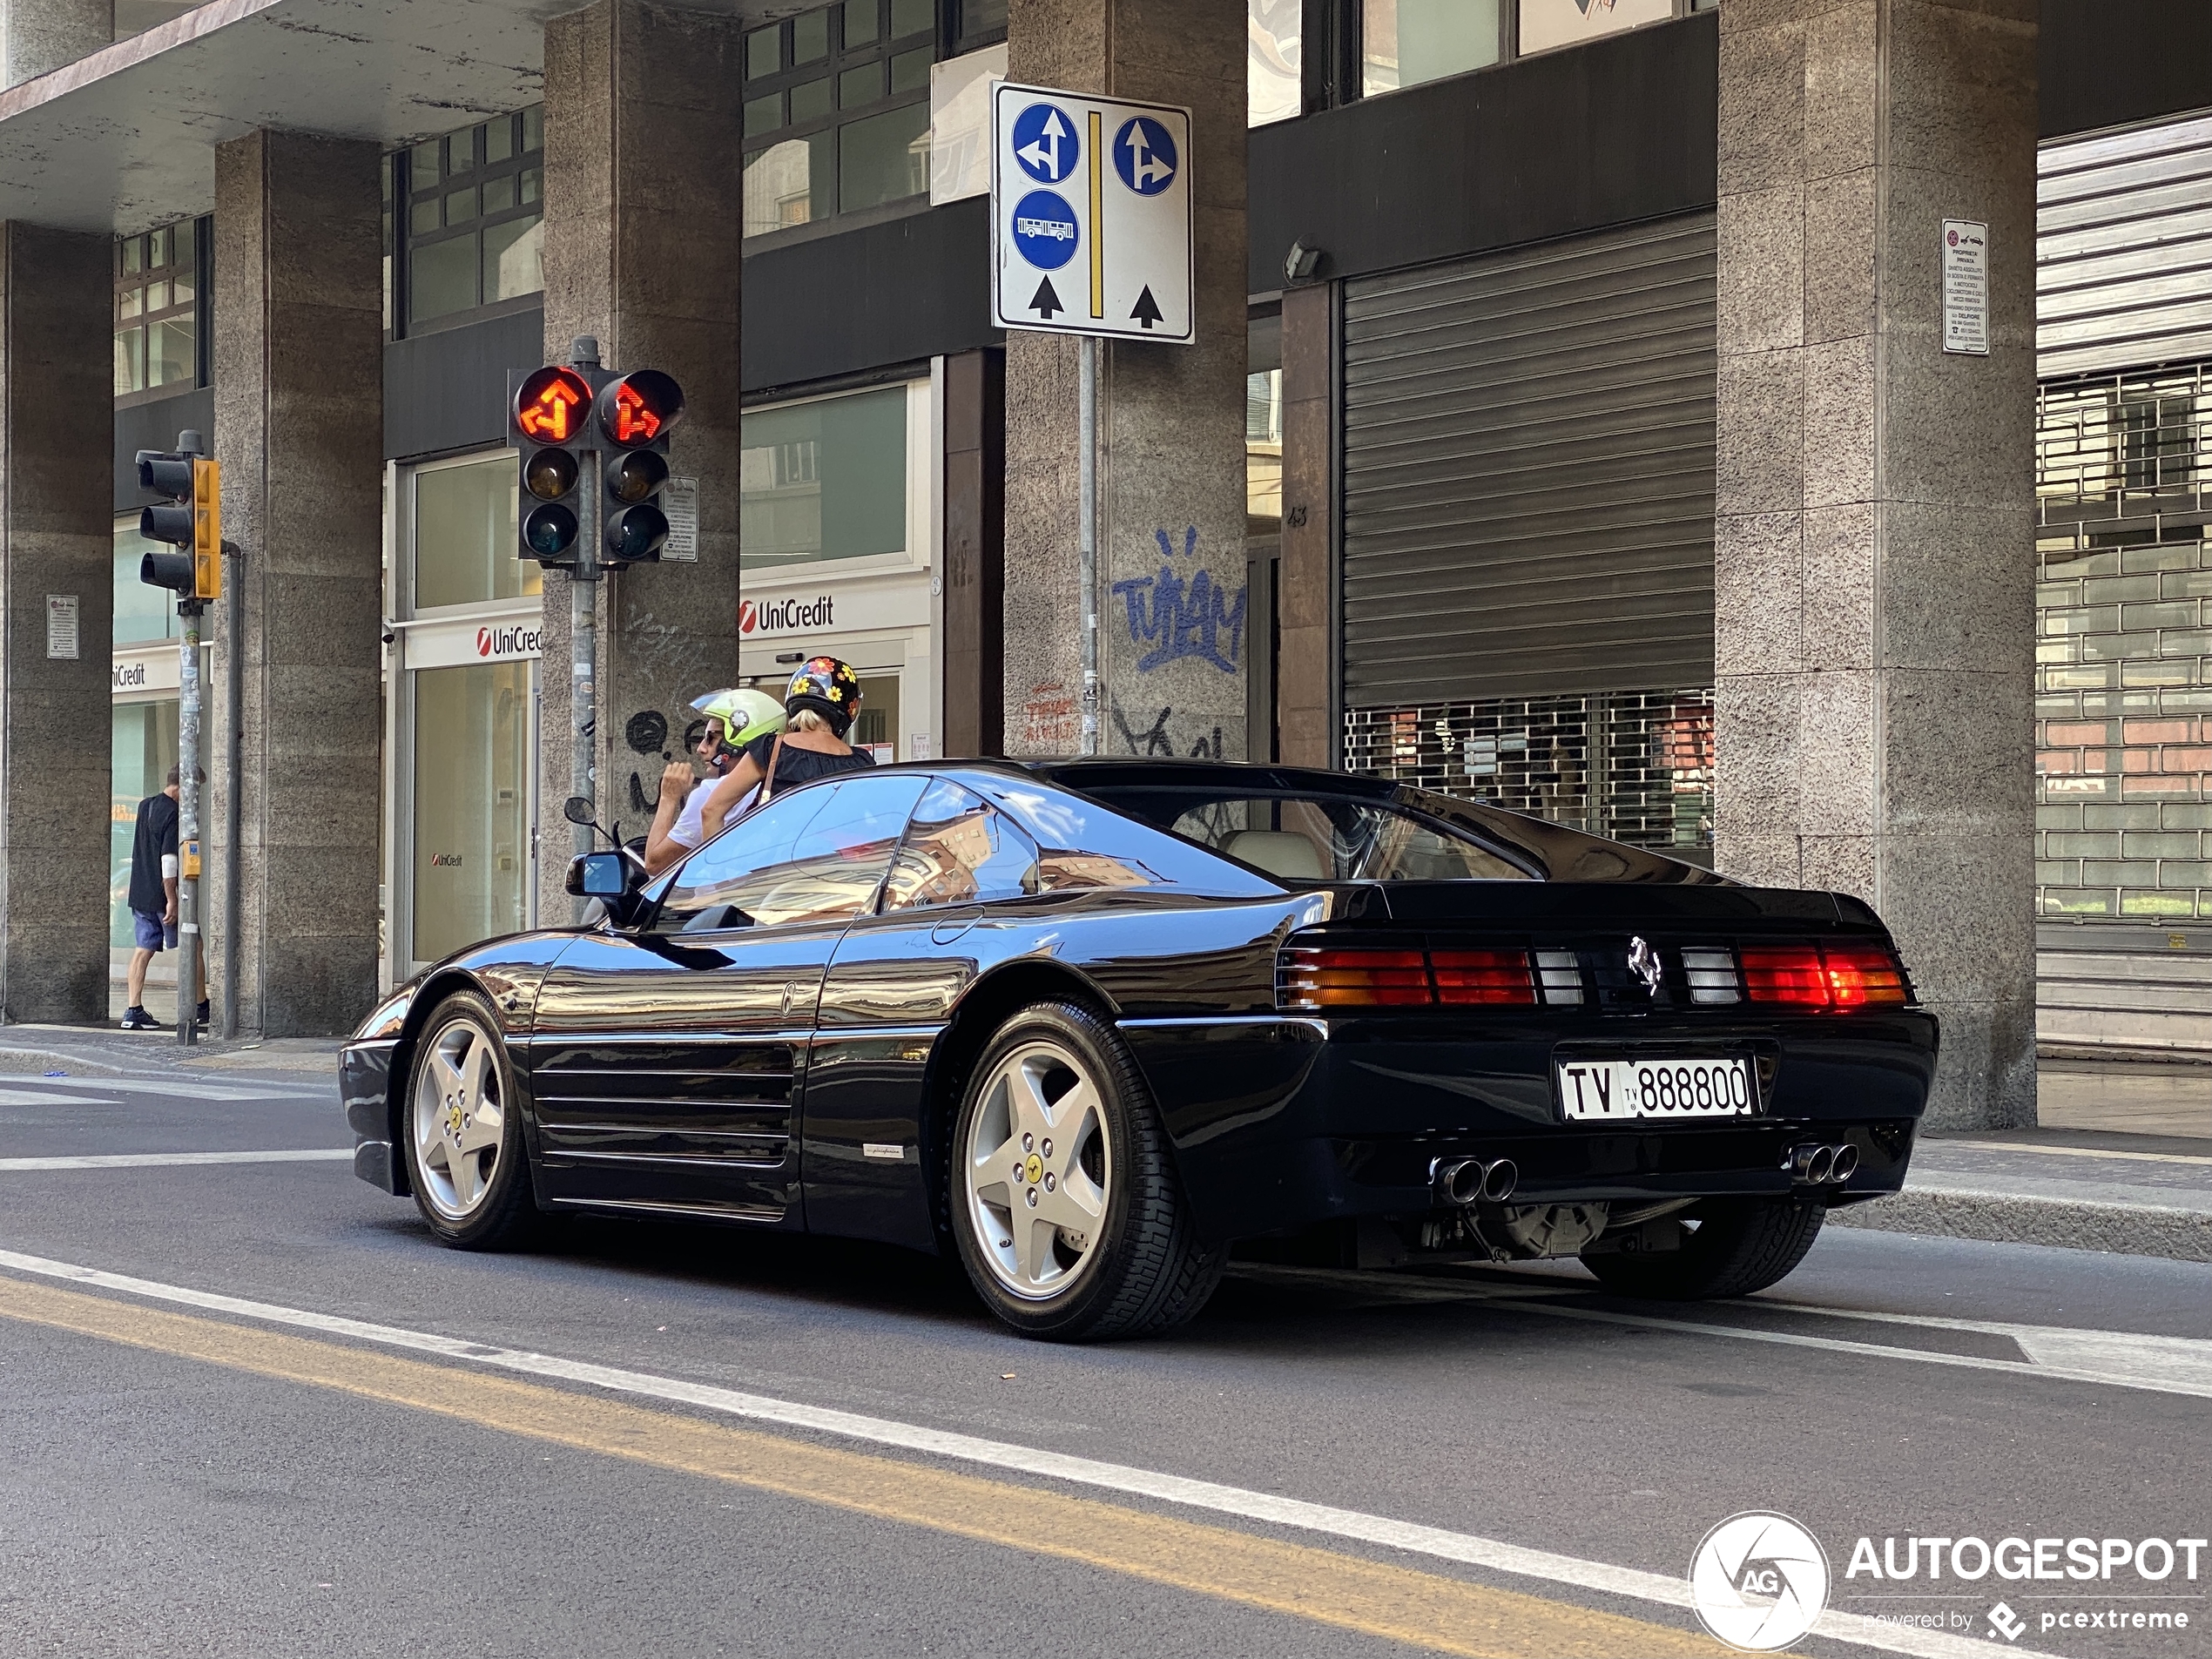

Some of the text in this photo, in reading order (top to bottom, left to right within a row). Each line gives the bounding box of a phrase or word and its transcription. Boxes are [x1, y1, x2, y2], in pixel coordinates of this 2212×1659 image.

[759, 595, 833, 631] UniCredit
[493, 625, 543, 655] UniCred
[438, 853, 462, 867] UniCredit
[1567, 1068, 1611, 1113] TV
[1638, 1066, 1749, 1111] 888800
